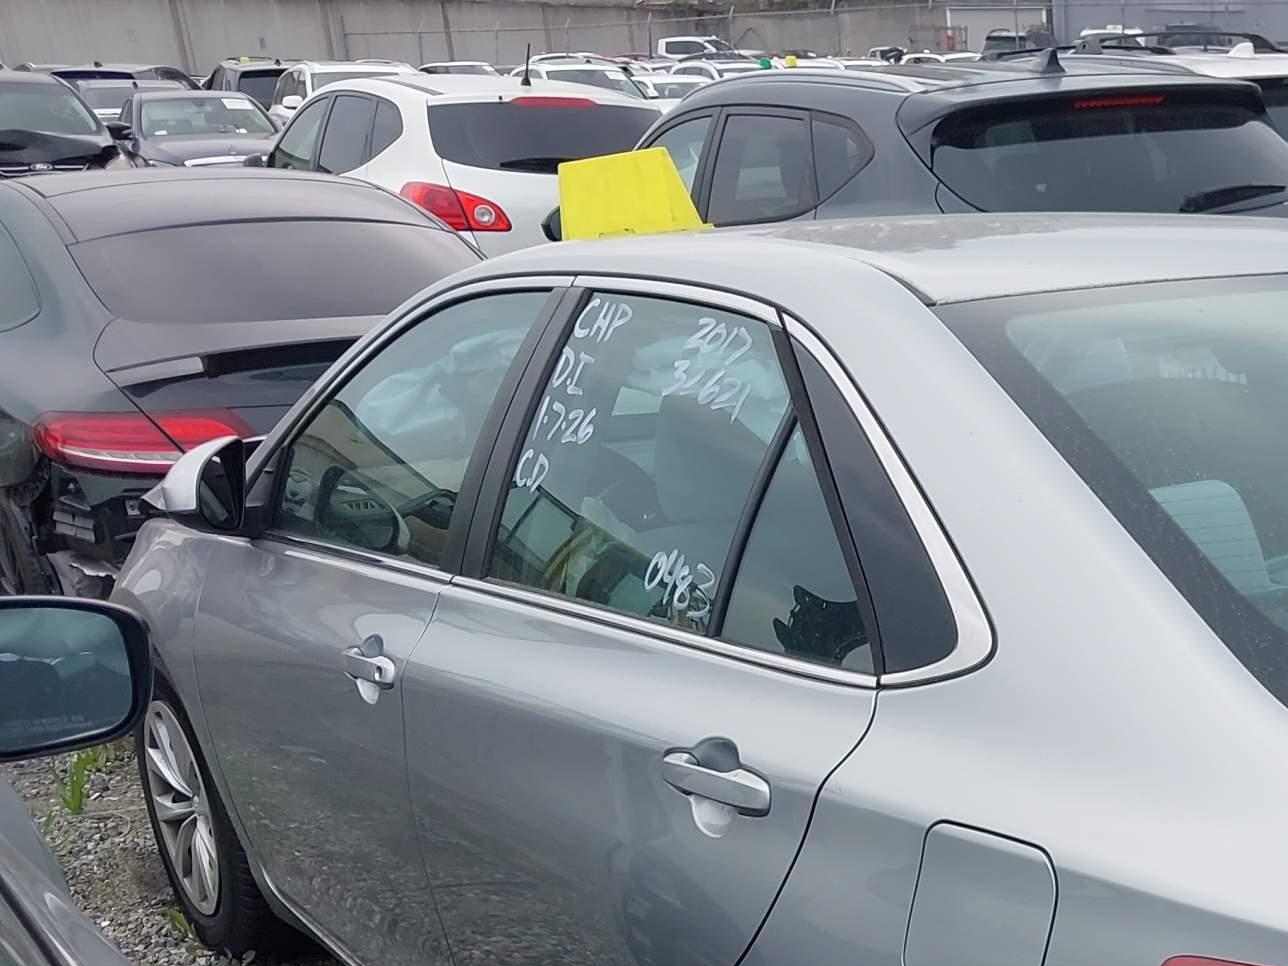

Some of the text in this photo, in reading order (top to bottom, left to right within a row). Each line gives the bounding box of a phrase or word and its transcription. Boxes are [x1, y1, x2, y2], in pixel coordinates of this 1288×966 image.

[573, 298, 632, 343] CHP
[684, 317, 752, 365] 2017
[661, 359, 751, 424] 32621
[644, 549, 714, 617] 0483
